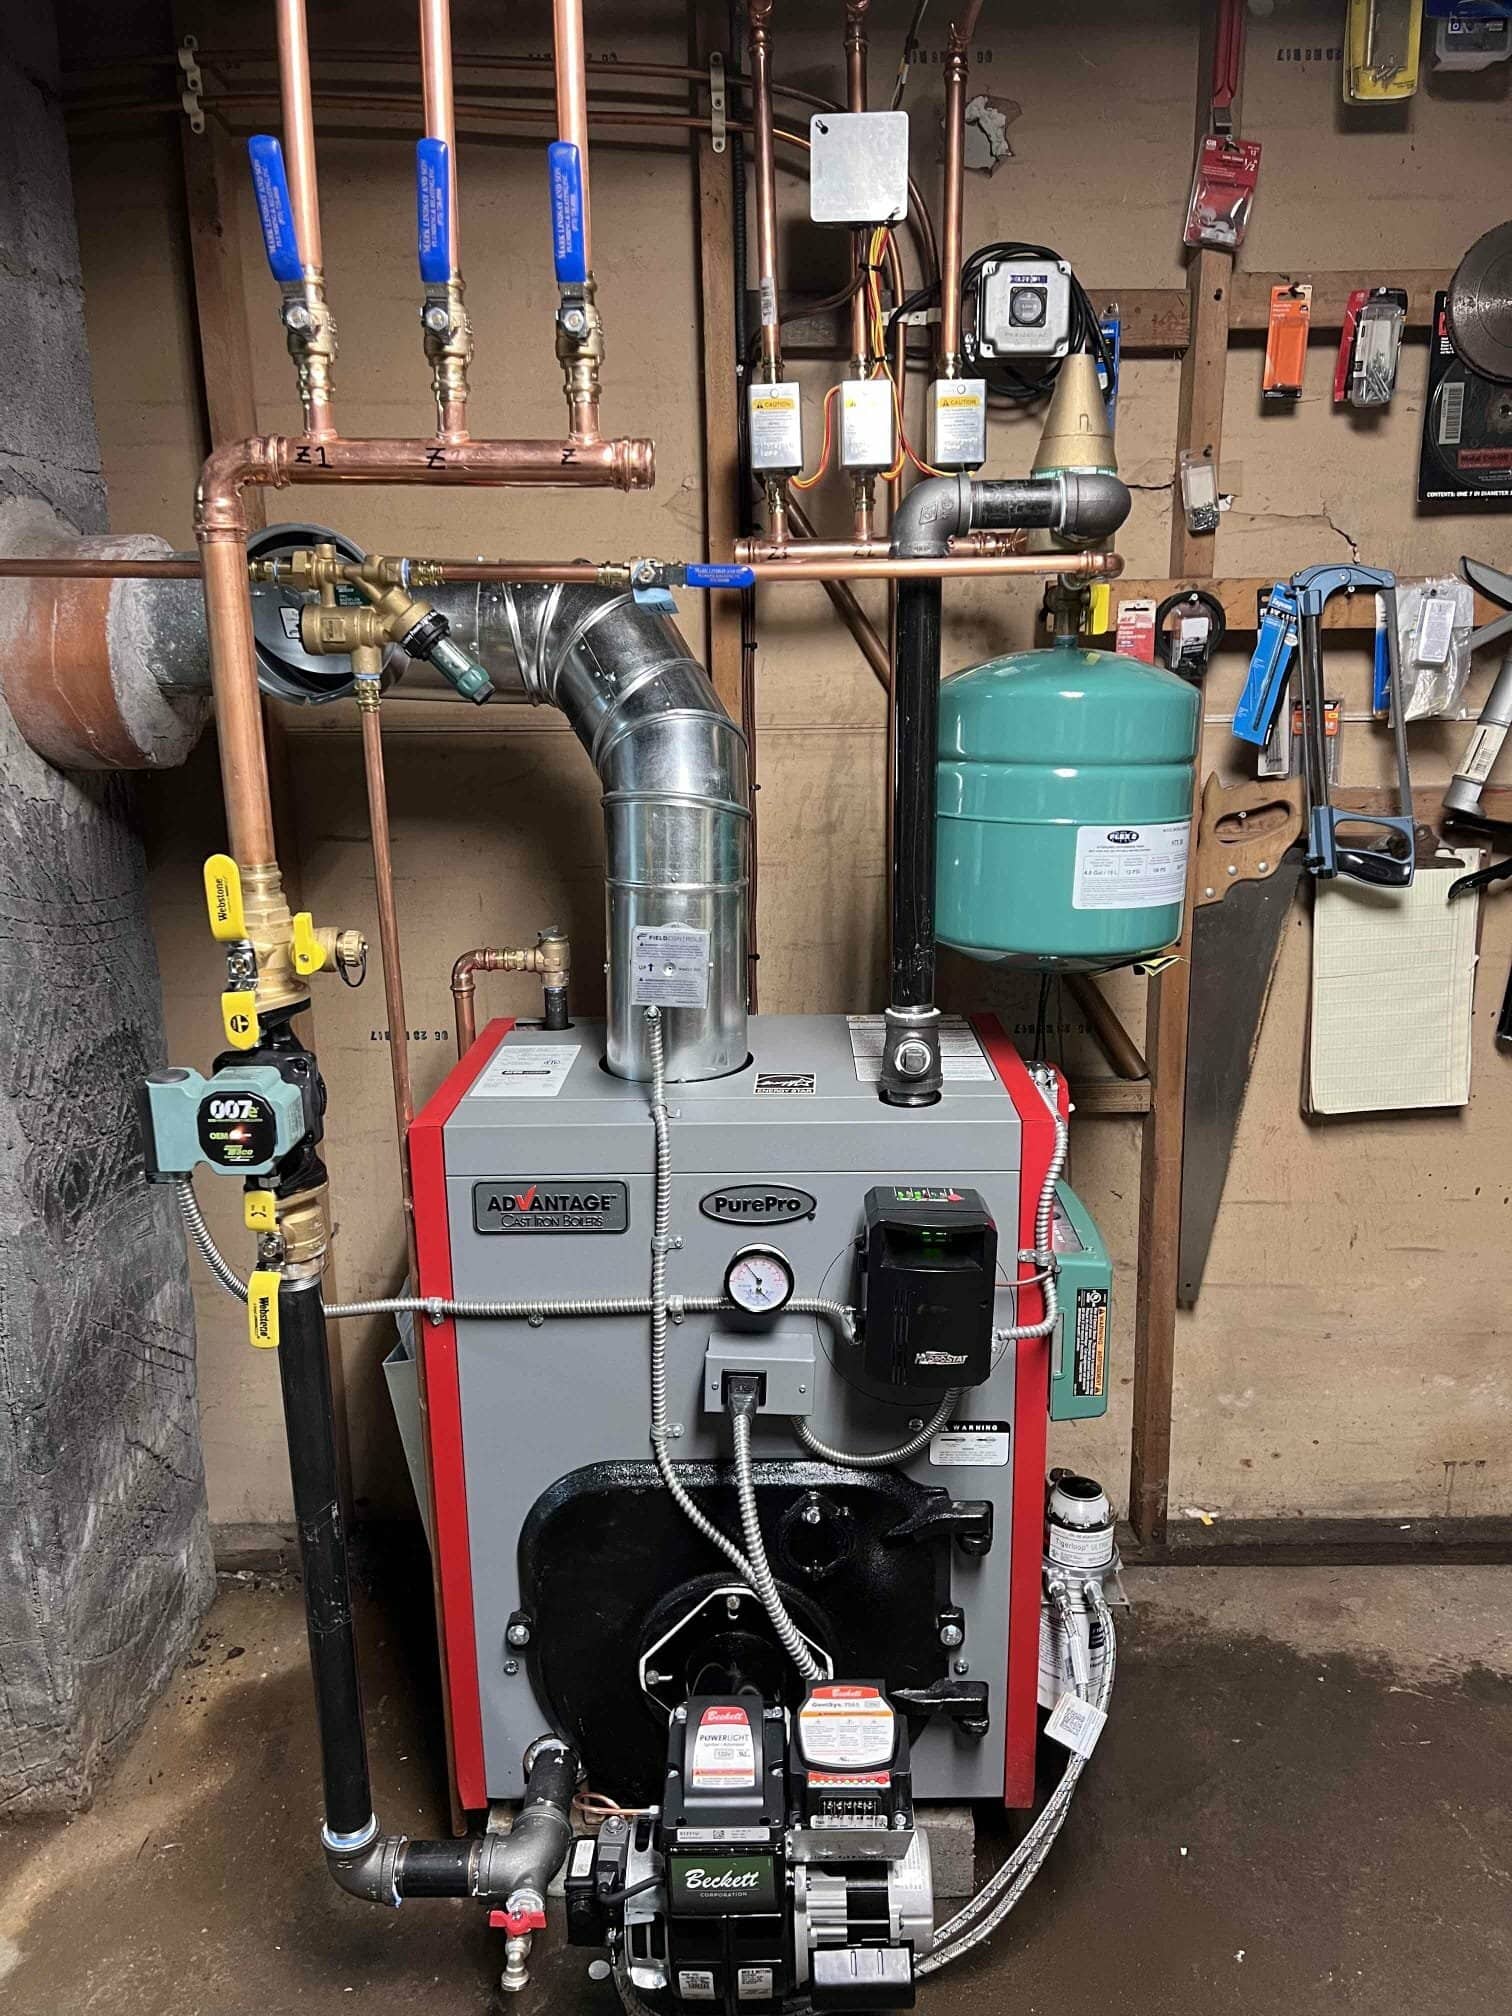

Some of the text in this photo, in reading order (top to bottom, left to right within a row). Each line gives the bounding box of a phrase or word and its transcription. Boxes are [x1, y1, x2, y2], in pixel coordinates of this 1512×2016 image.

[295, 446, 333, 469] Z1
[216, 878, 228, 922] Webstone
[488, 1187, 612, 1212] ADVANTAGE
[714, 1196, 801, 1213] PurePro
[501, 1214, 604, 1227] CAST IRON BOILERS
[707, 1710, 744, 1721] Beckett
[684, 1868, 760, 1889] Beckett
